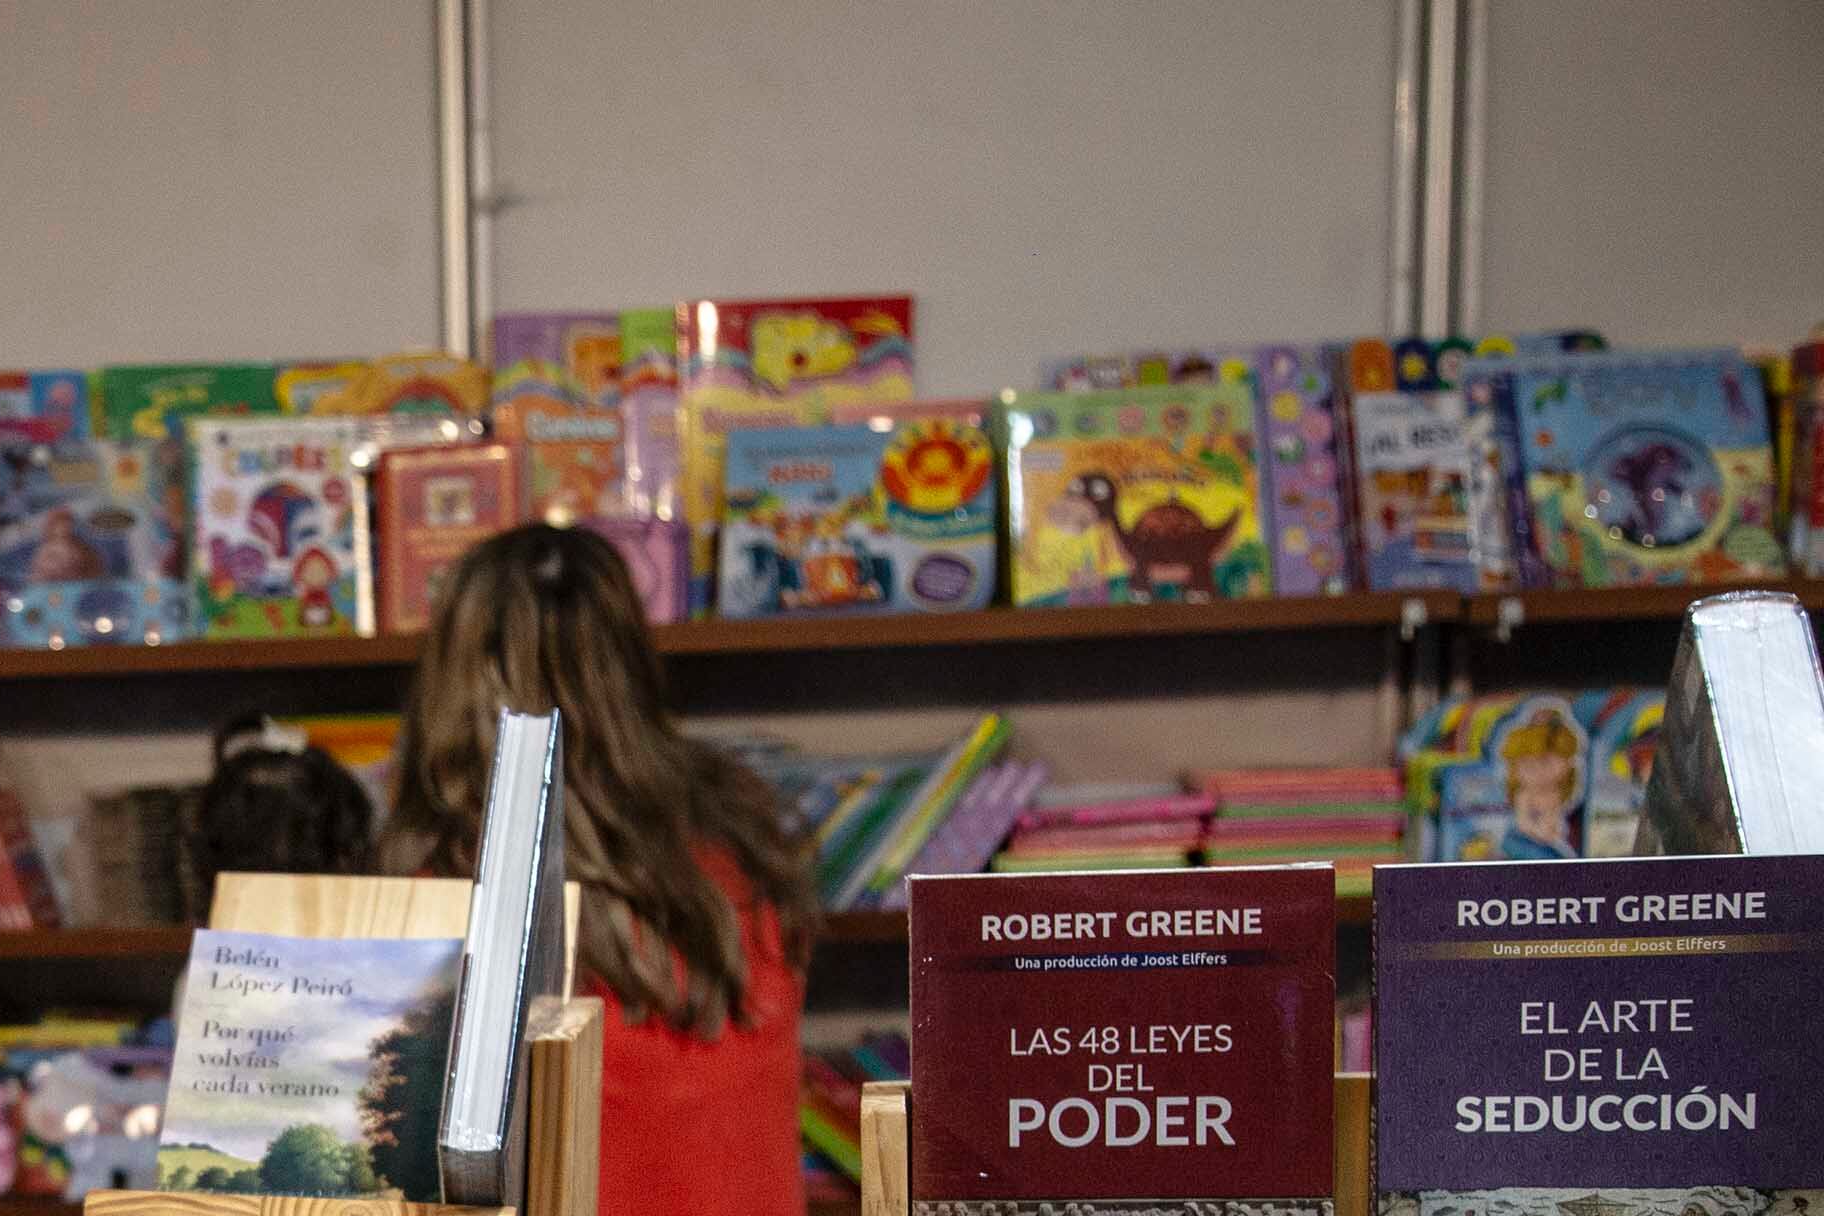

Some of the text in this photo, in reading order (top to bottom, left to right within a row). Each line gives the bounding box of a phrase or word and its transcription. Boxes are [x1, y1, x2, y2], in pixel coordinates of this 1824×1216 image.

[981, 908, 1263, 941] ROBERT GREENE
[1457, 892, 1767, 927] ROBERT GREENE
[213, 945, 280, 969] Belén
[1015, 951, 1227, 971] Una producción de Joost Elffers
[1493, 937, 1726, 957] Una producción de Joost Elffers
[208, 971, 354, 998] López Peiró
[1520, 999, 1694, 1035] EL ARTE
[201, 1019, 295, 1049] Por qué
[1010, 1024, 1233, 1056] LAS 48 LEYES
[196, 1048, 281, 1071] volvías
[1544, 1048, 1669, 1081] DE LA
[192, 1072, 340, 1099] cada verano
[1088, 1064, 1154, 1092] DEL
[1008, 1095, 1236, 1148] PODER
[1455, 1086, 1756, 1132] SEDUCCIÓN
